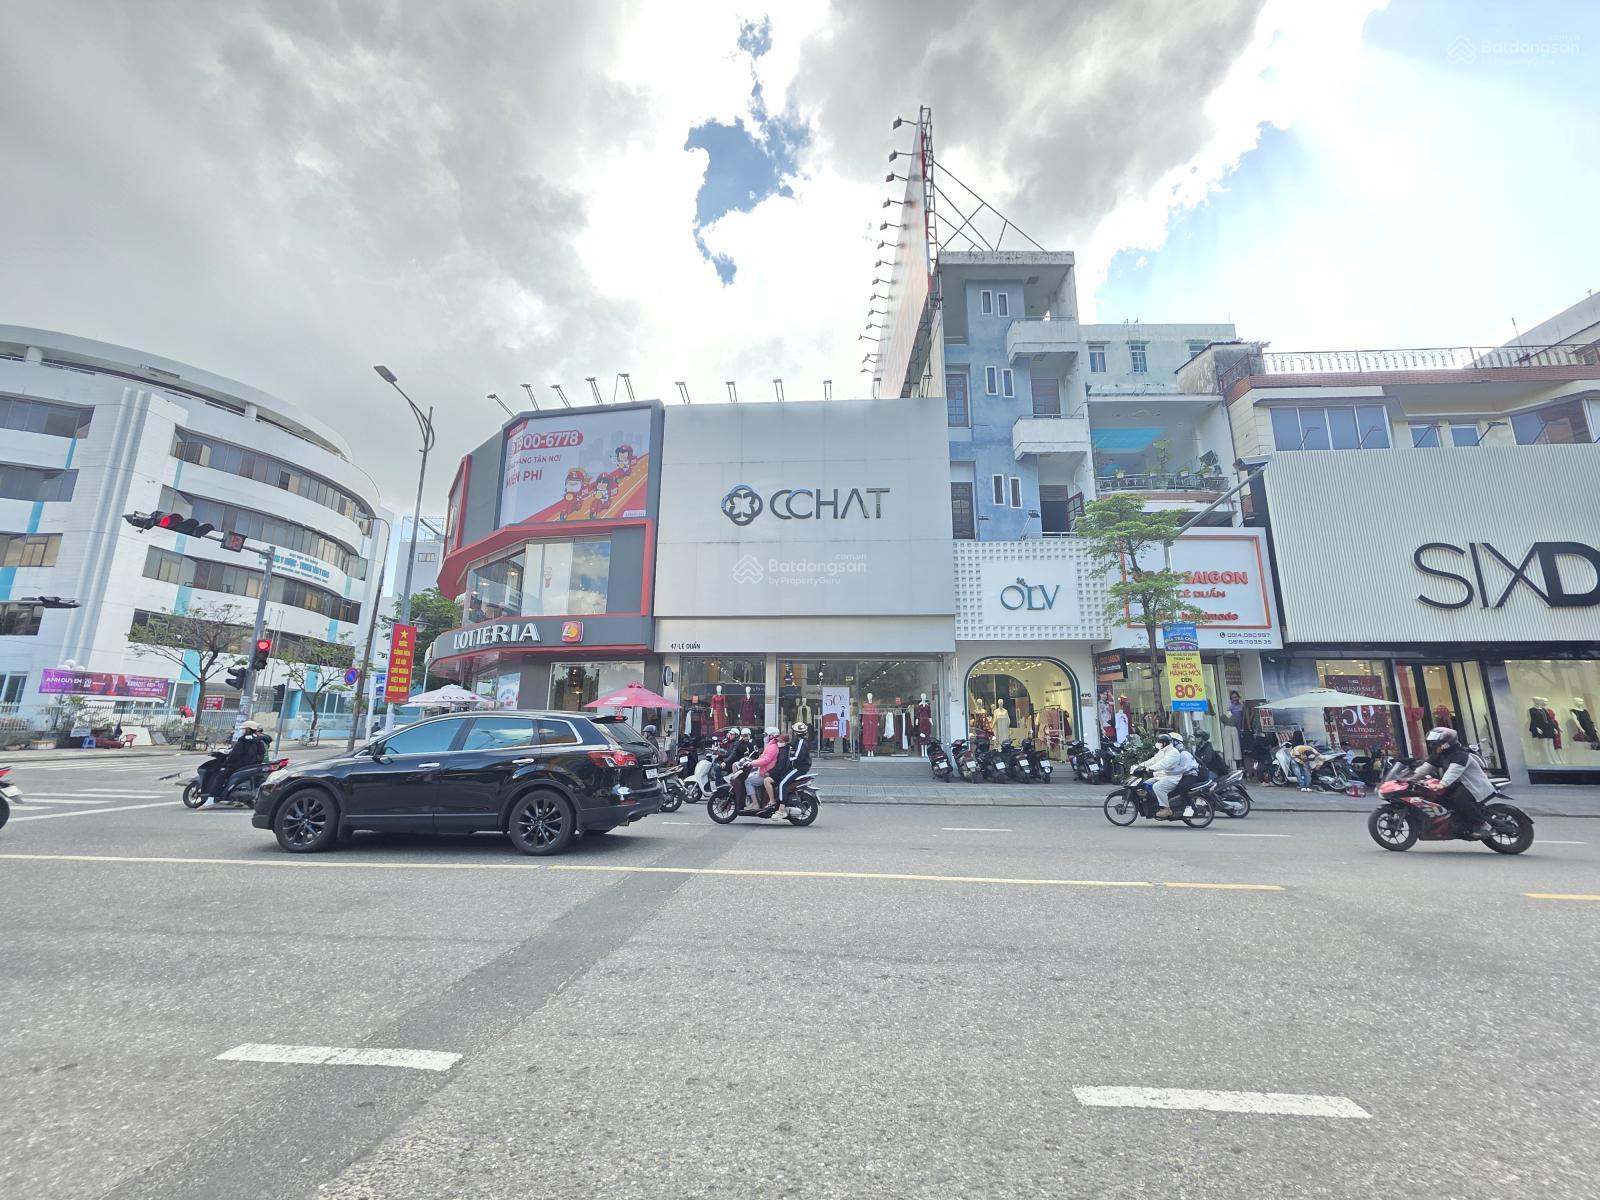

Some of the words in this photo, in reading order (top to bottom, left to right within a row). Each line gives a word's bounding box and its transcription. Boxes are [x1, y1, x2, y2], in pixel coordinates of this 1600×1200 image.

[523, 466, 542, 482] PHÍ
[769, 488, 890, 520] CCHAT
[1183, 570, 1249, 585] SAIGON
[453, 622, 541, 650] LOTTERIA
[1175, 684, 1203, 698] 80%
